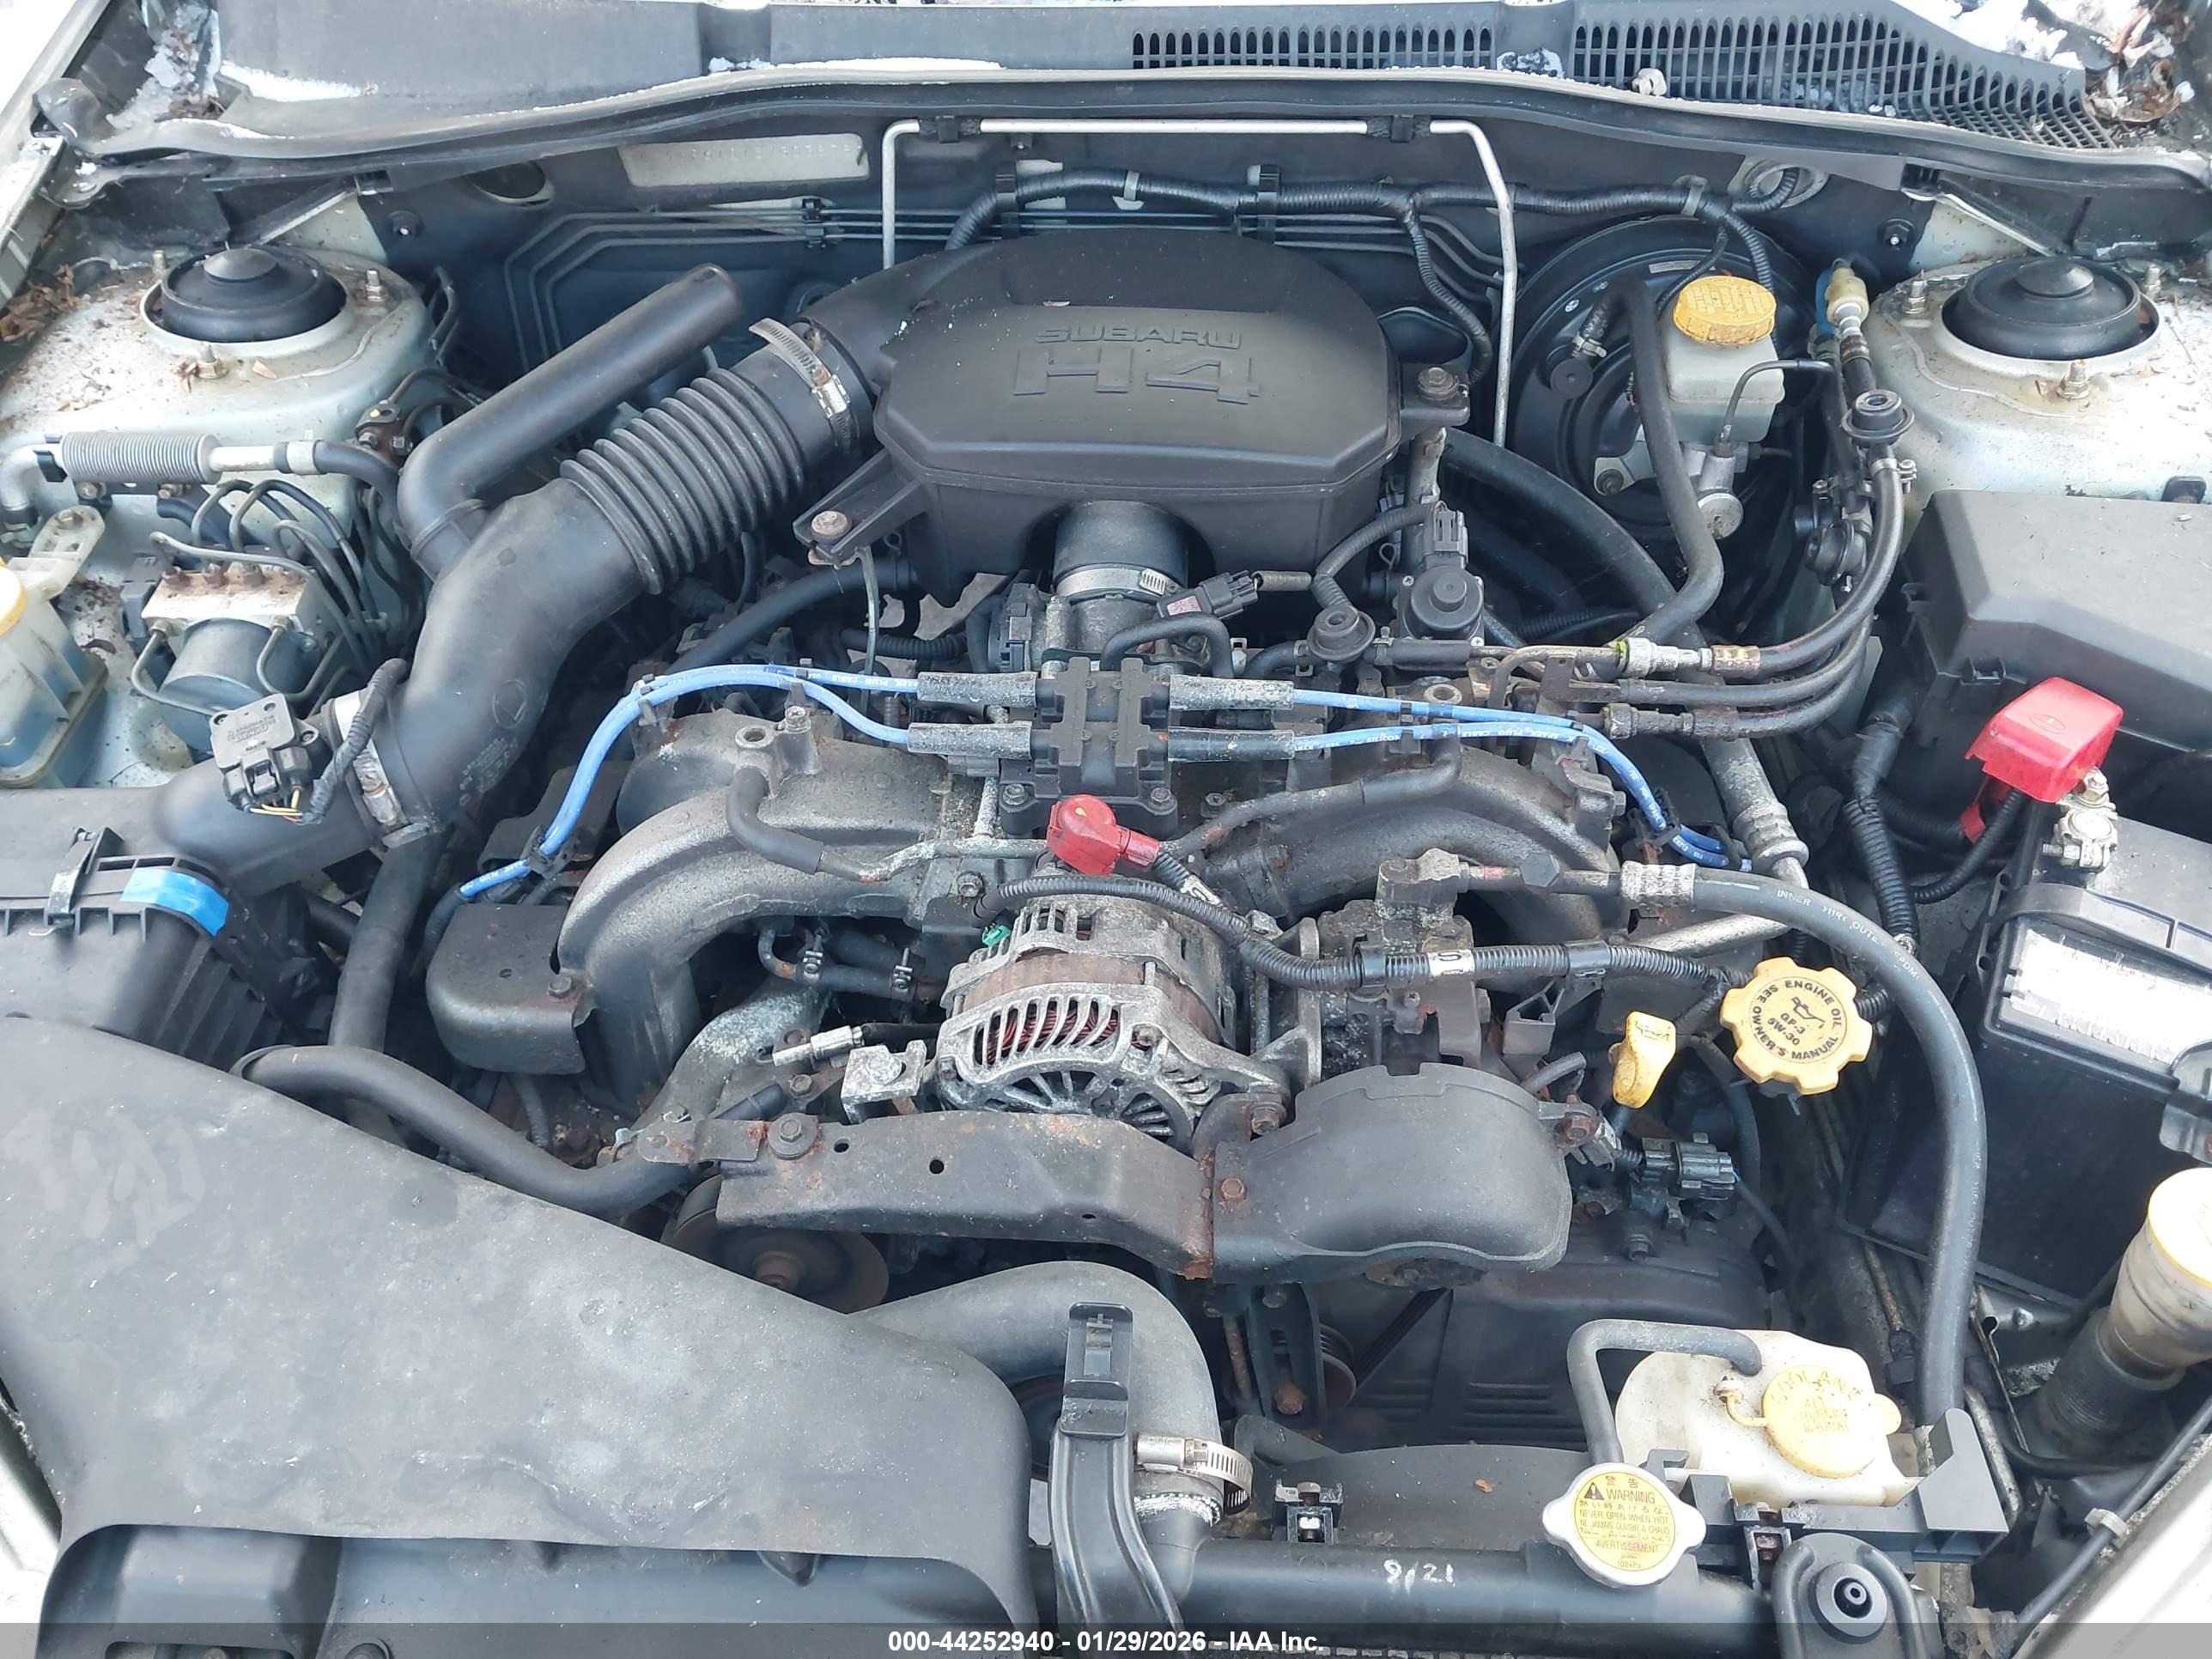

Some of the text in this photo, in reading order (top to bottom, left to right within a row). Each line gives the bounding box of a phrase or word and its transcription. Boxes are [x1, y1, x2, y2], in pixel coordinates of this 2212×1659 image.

[1036, 325, 1242, 349] SUBARU
[1013, 345, 1261, 404] H4
[1784, 980, 1842, 1029] ENGINE OIL
[1752, 984, 1838, 1060] SEE OWNER'S MANUAL
[1767, 1017, 1802, 1046] 5W-30
[1606, 1488, 1656, 1504] WARNING
[1579, 1509, 1669, 1524] NEVER OPEN WHEN HOT
[1592, 1520, 1613, 1529] JAMAIS
[1648, 1526, 1670, 1535] CHAUD
[1595, 1540, 1659, 1553] AVERTISSEMENT
